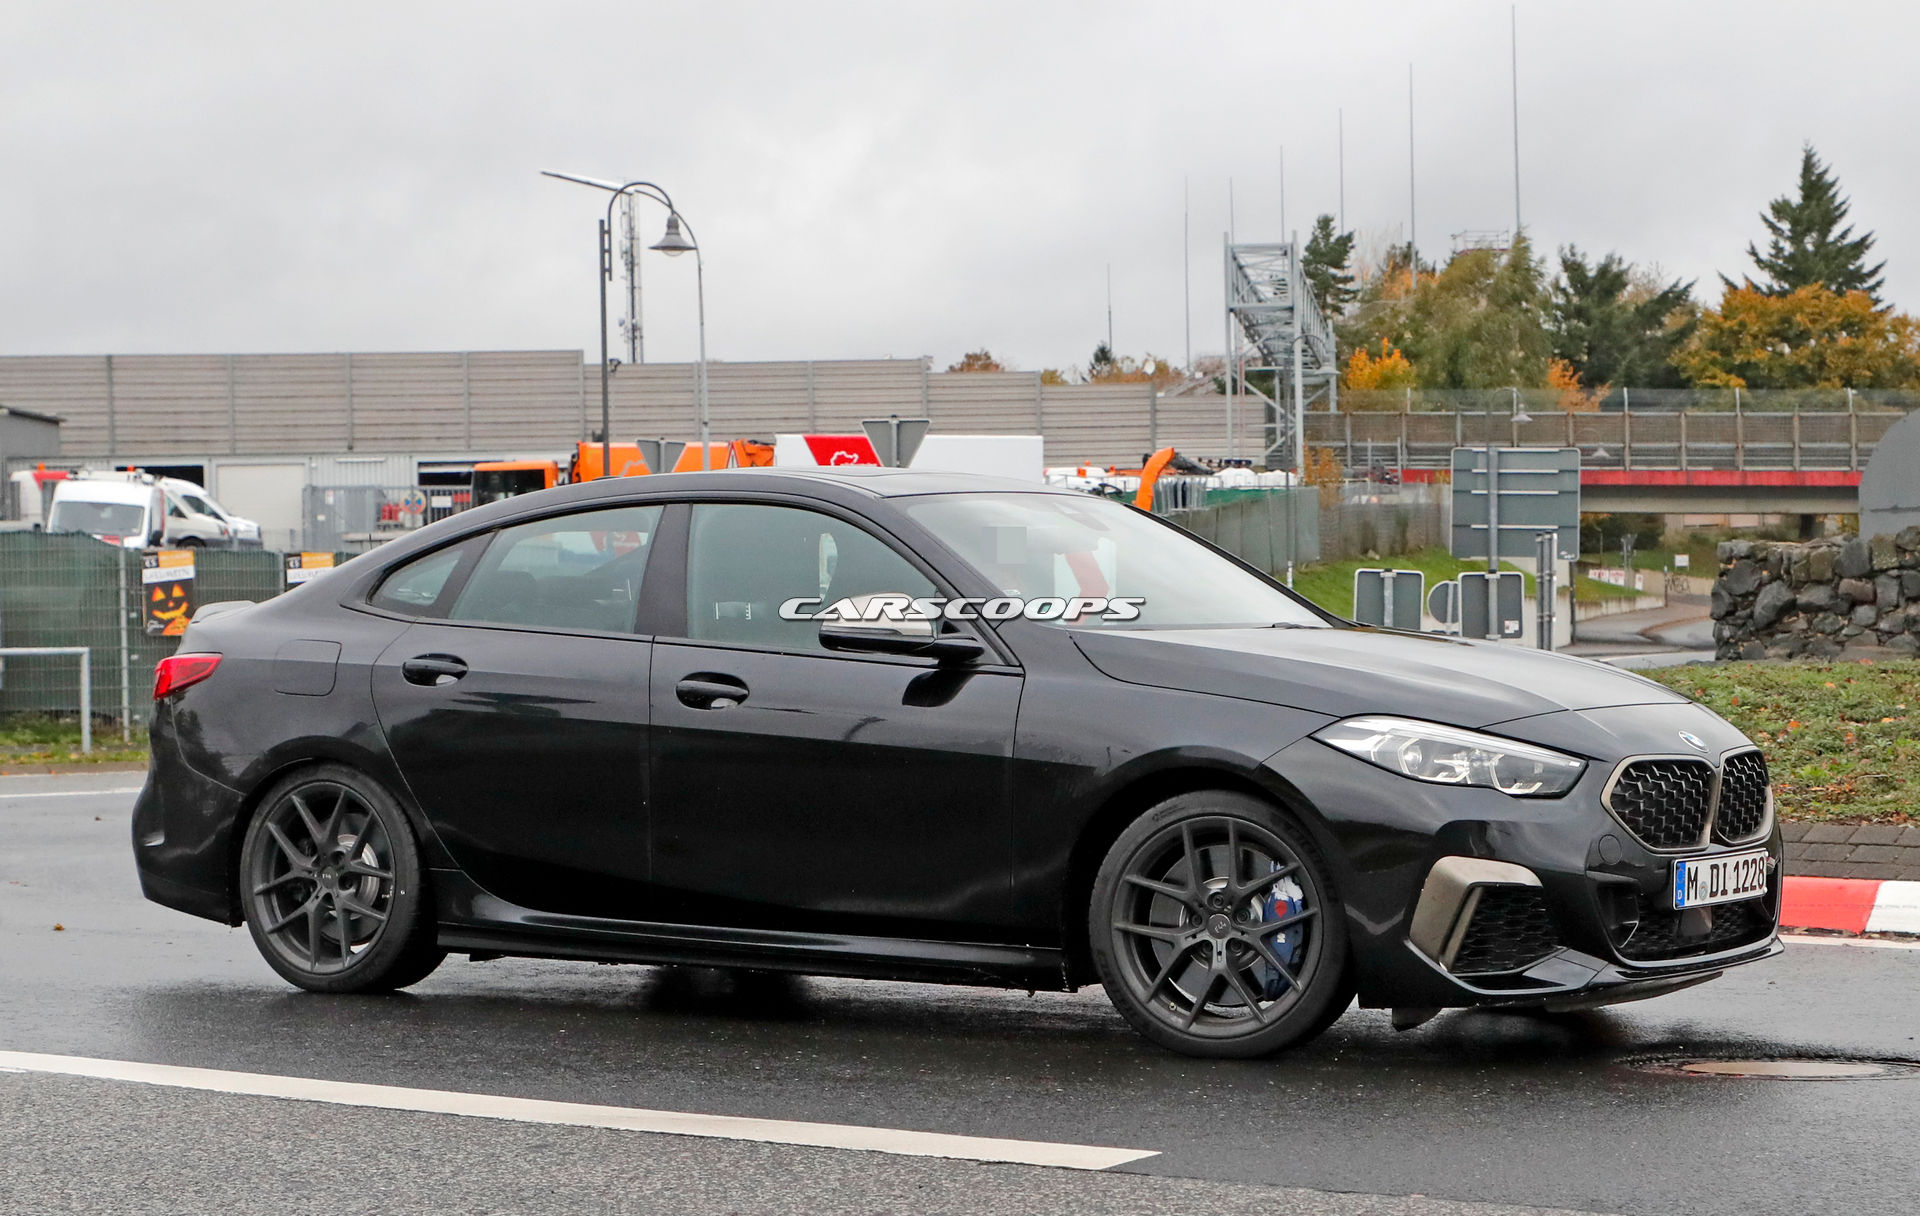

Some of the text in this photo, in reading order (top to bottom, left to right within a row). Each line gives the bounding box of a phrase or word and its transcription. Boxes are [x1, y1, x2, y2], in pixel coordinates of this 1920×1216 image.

[1686, 857, 1765, 901] M DI 1228
[1677, 889, 1683, 900] D
